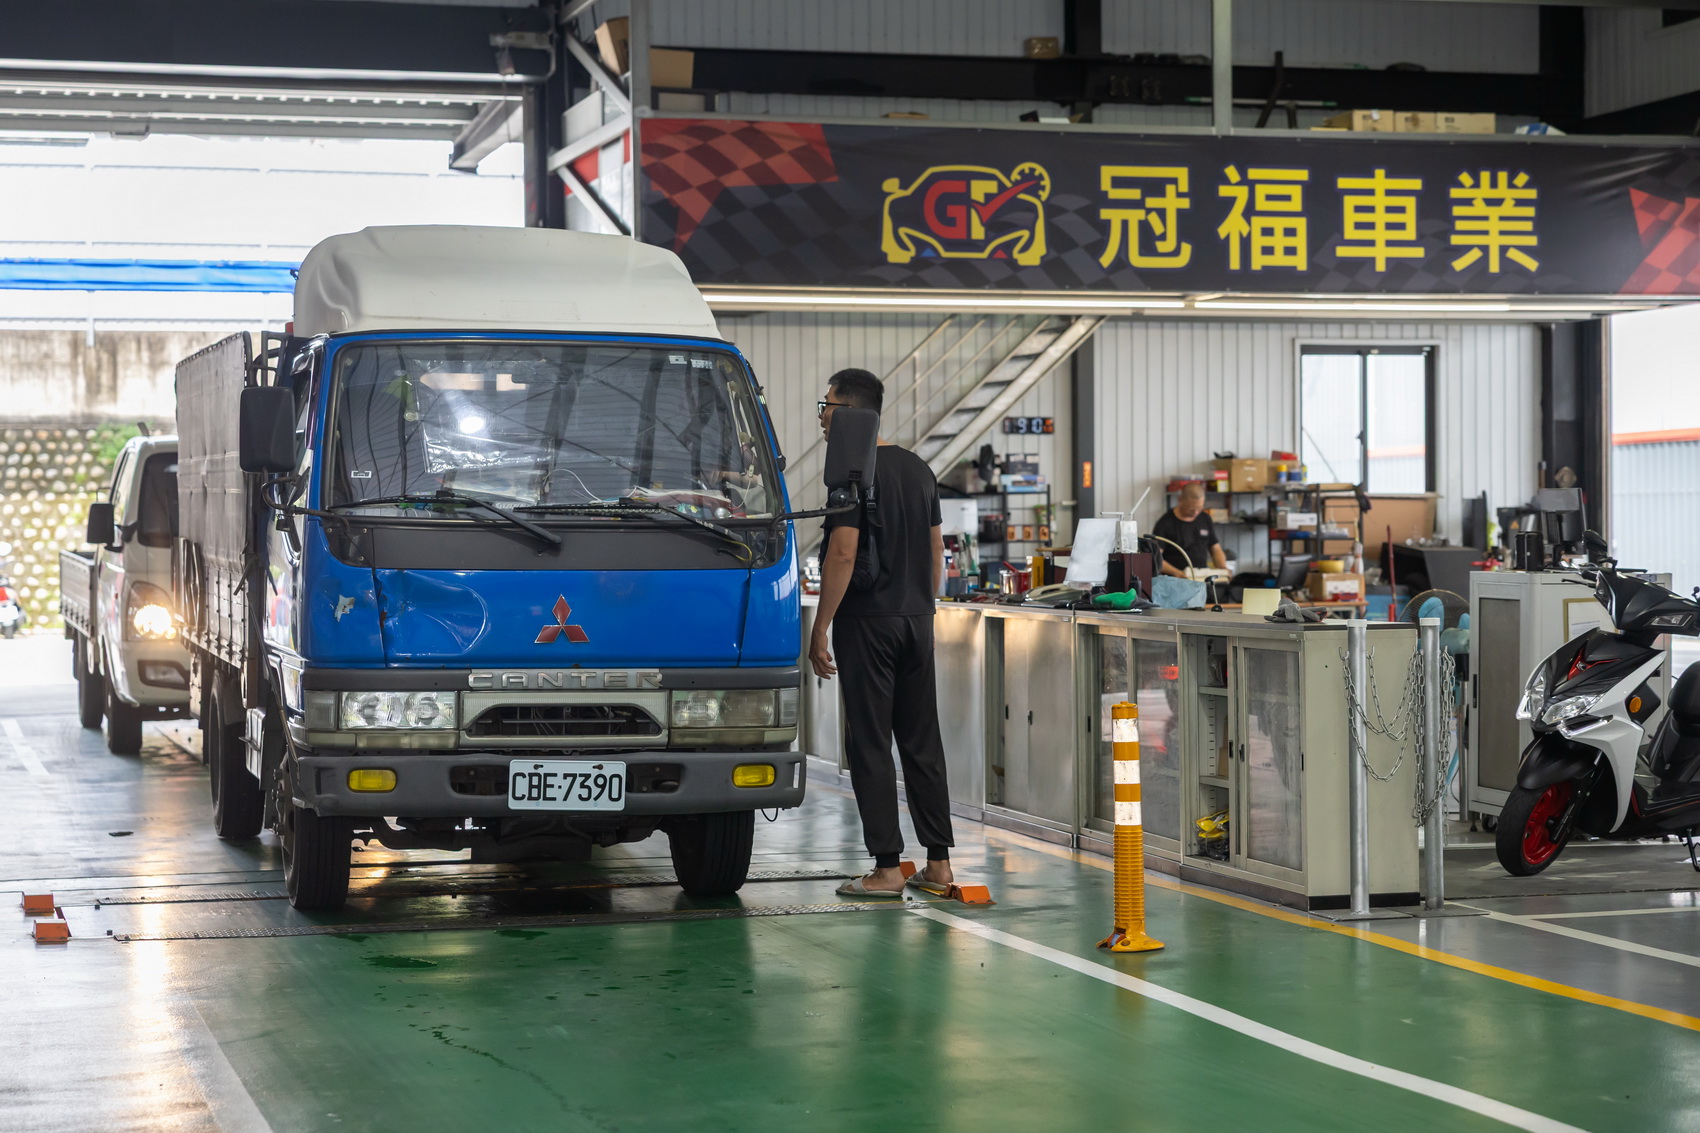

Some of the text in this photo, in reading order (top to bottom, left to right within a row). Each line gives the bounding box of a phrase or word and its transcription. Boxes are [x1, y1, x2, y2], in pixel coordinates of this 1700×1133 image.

[1098, 164, 1540, 274] 冠福車業
[468, 671, 663, 688] CANTER
